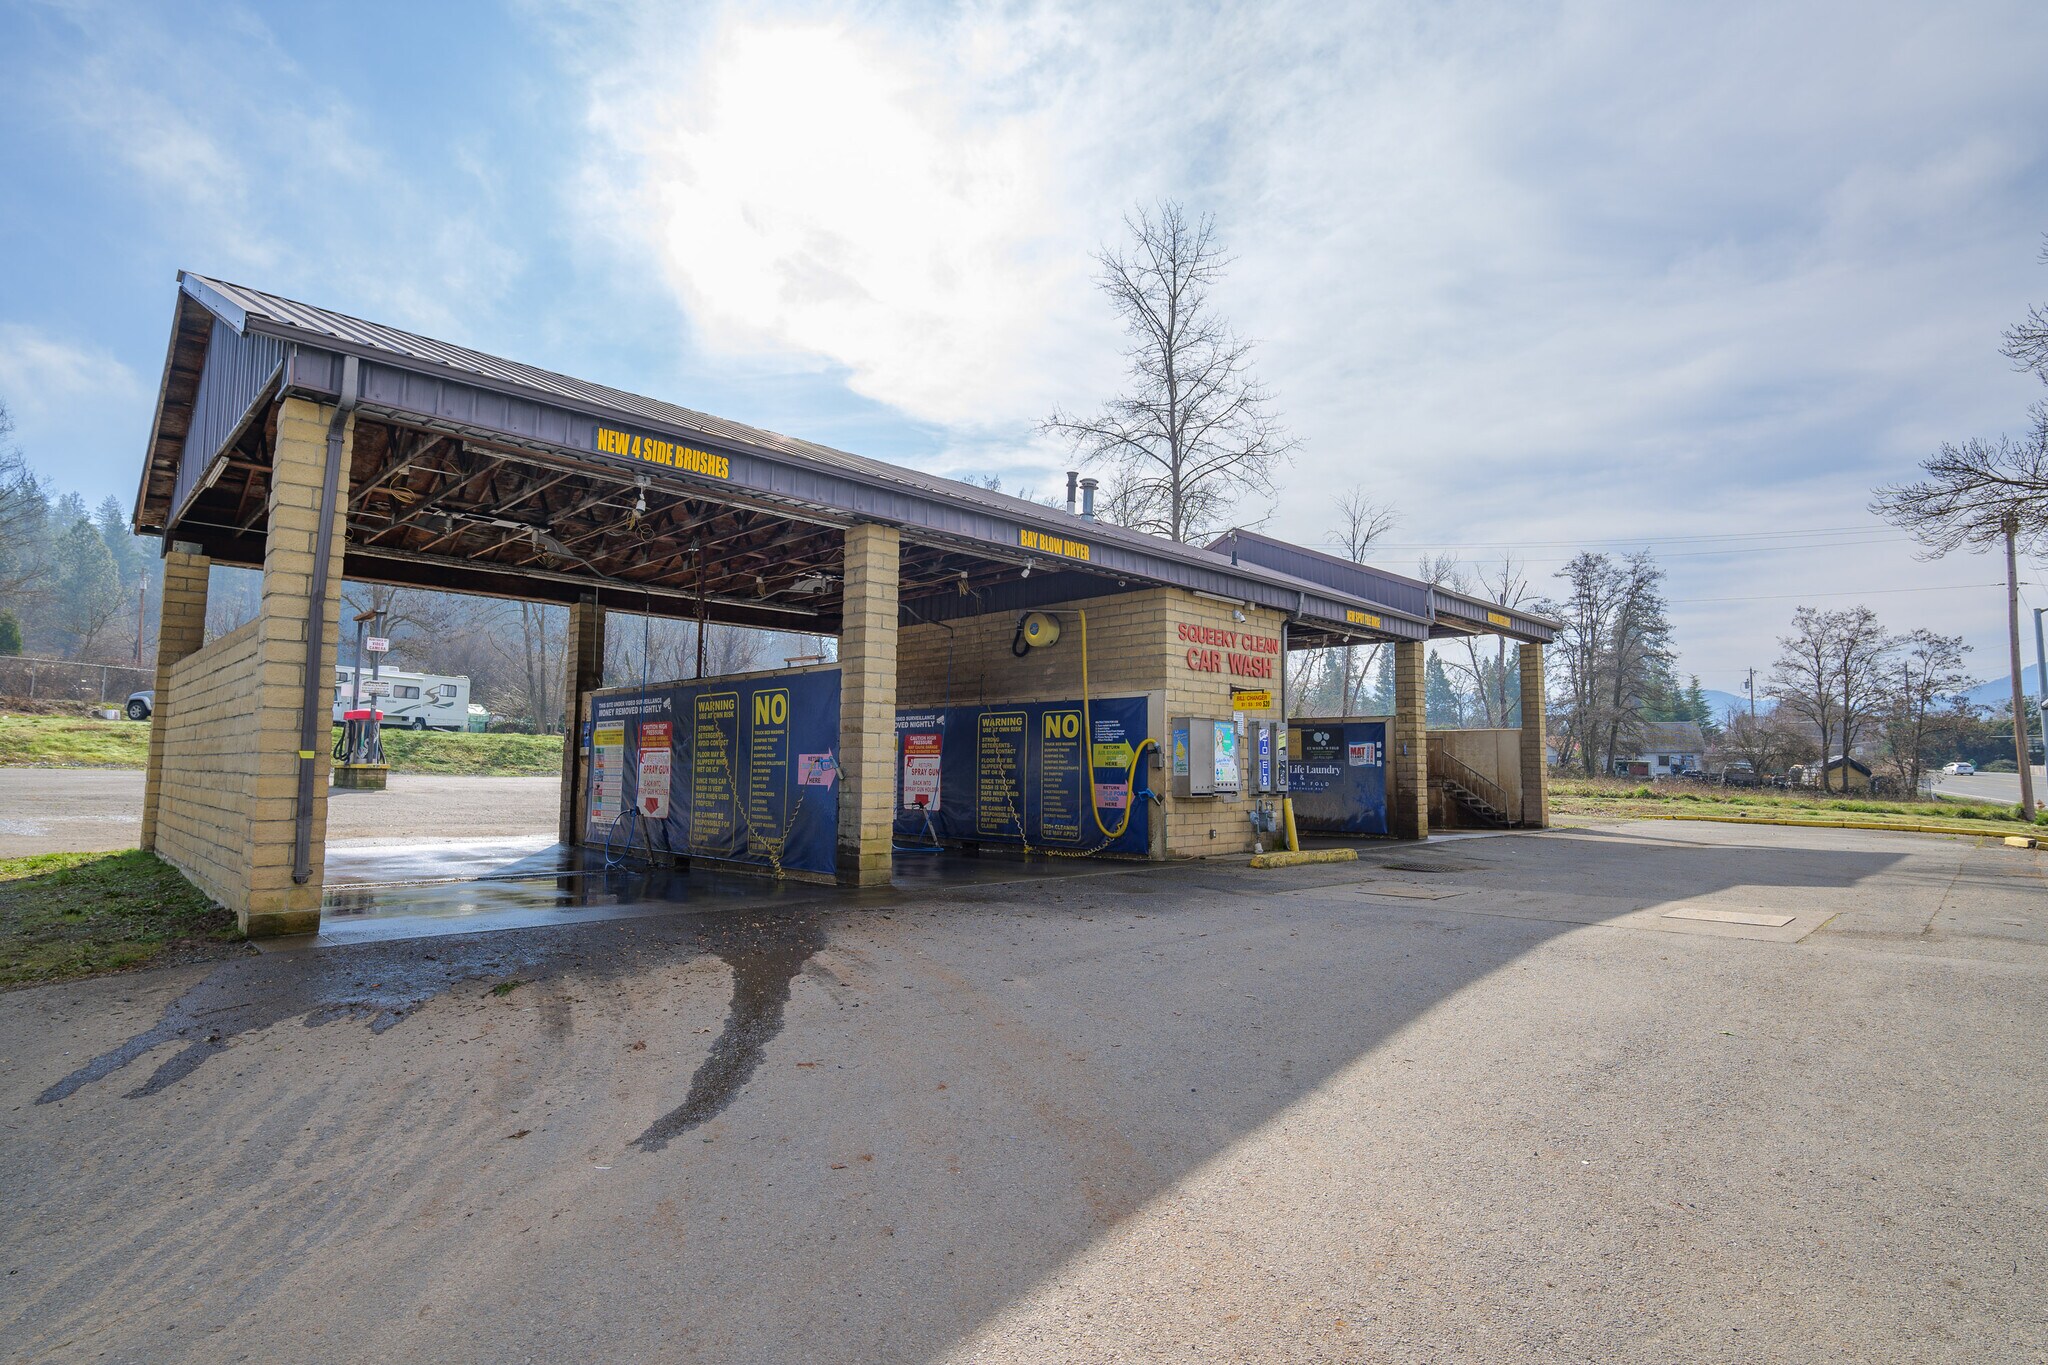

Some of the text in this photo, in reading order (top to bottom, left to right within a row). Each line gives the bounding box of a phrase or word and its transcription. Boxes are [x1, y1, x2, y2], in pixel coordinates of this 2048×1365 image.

[598, 428, 728, 479] NEW 4 SIDE BRUSHES
[1021, 529, 1089, 560] BAY BLOW DRYER
[1178, 623, 1278, 654] SQUEEKY CLEAN
[1187, 647, 1272, 678] CAR WASH
[615, 707, 638, 716] REMOVED
[698, 699, 734, 712] WARNING
[755, 694, 786, 725] NO
[982, 718, 1022, 726] WARNING
[1046, 714, 1079, 738] NO
[1350, 747, 1365, 755] MAT
[643, 765, 669, 774] SPRAY GUN
[1290, 765, 1341, 776] Life Laundry
